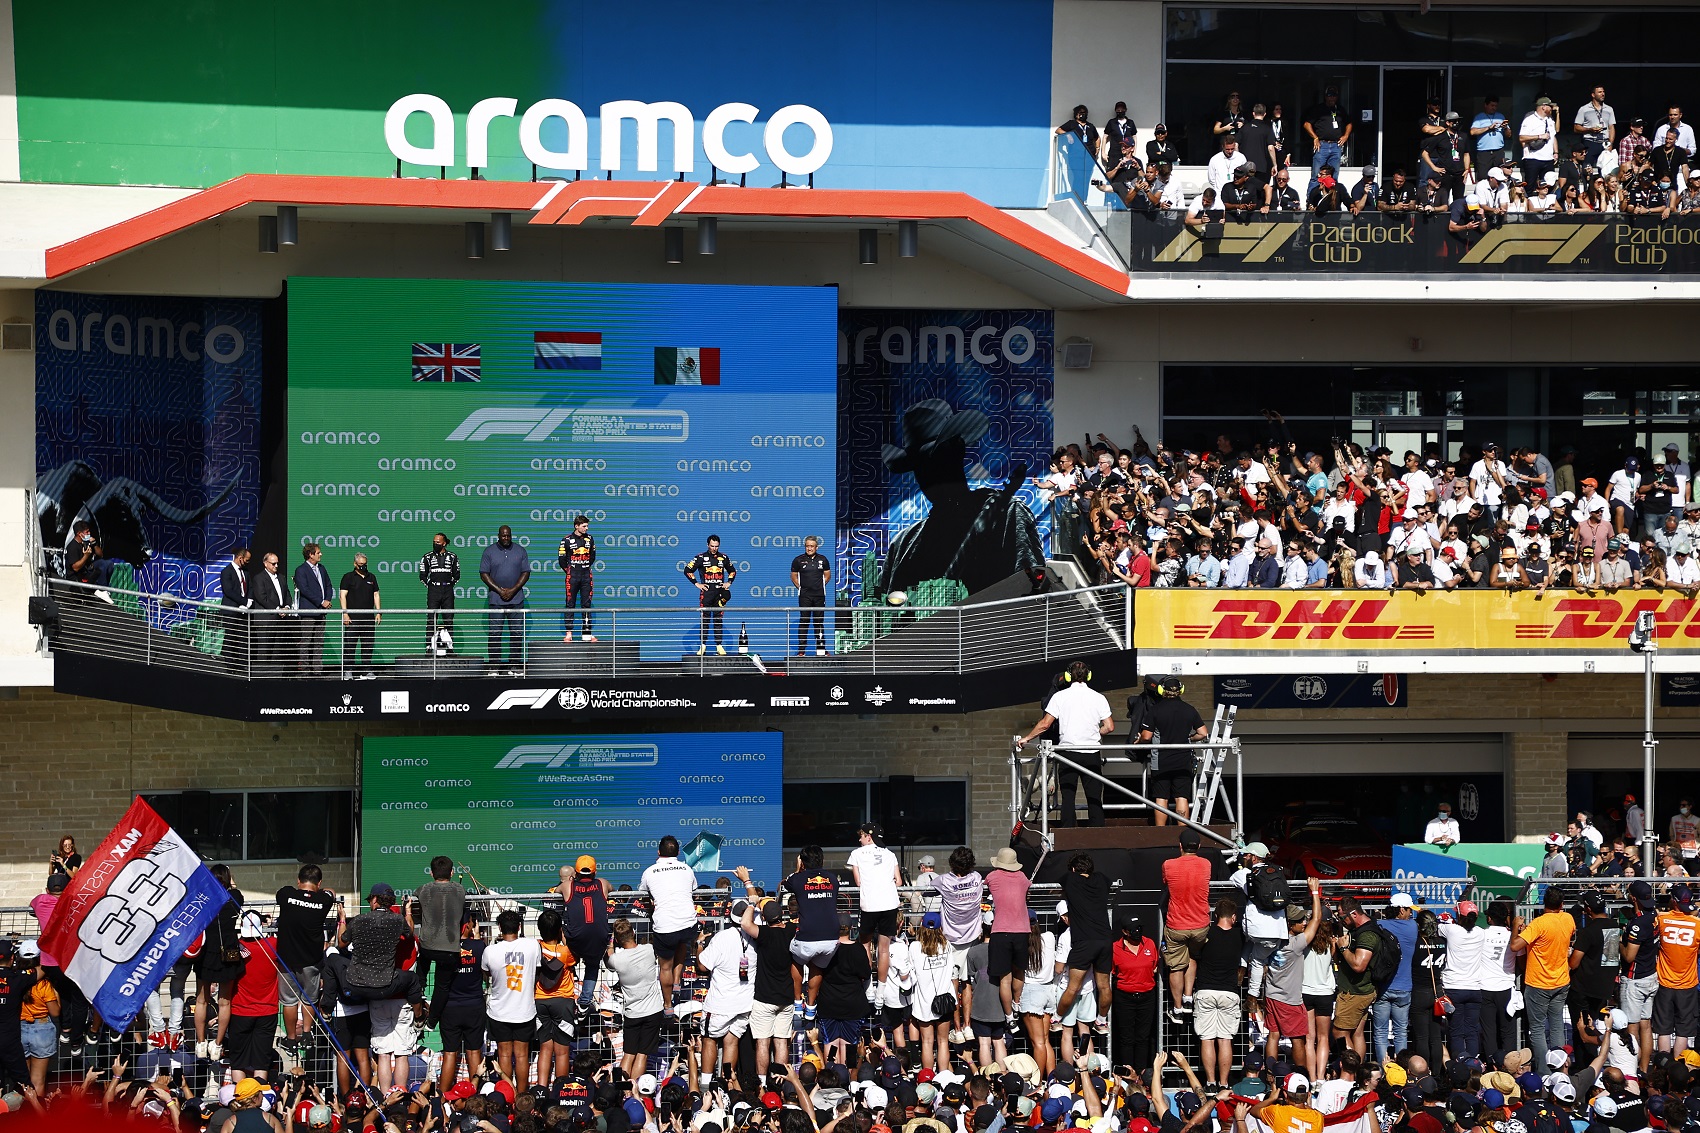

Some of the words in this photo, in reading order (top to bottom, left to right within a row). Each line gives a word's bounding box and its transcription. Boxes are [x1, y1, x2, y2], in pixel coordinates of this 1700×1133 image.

[384, 93, 834, 175] aramco
[1309, 222, 1414, 244] Paddock
[1309, 242, 1362, 263] Club
[1615, 245, 1667, 265] Club
[49, 309, 245, 364] aramco
[838, 325, 1035, 364] ramco
[35, 364, 160, 408] AUSTIN
[168, 373, 262, 414] 2021
[957, 378, 1054, 412] 2021
[35, 405, 160, 446] AUSTIN
[166, 413, 261, 451] 2021
[301, 431, 380, 445] aramco
[751, 435, 825, 448] aramco
[378, 458, 456, 471] aramco
[530, 458, 607, 471] aramco
[676, 459, 751, 472] aramco
[301, 483, 380, 497] aramco
[453, 484, 531, 497] aramco
[604, 484, 680, 497] aramco
[750, 485, 825, 498] aramco
[378, 509, 456, 522] aramco
[676, 510, 751, 523] aramco
[301, 535, 380, 548] aramco
[604, 535, 679, 548] aramco
[604, 585, 679, 598] aramco
[1207, 599, 1400, 639] DHL
[1549, 599, 1700, 639] DH
[559, 688, 588, 709] FIA
[591, 690, 607, 698] FIA
[609, 689, 650, 698] Formula
[591, 699, 621, 708] World
[622, 699, 690, 709] Championship
[714, 699, 754, 707] DHL
[770, 696, 810, 707] PIRELLI
[909, 698, 956, 706] #PurposeDriven
[329, 706, 364, 714] ROLEX
[425, 703, 470, 713] aramco
[381, 758, 429, 767] aramco
[721, 753, 766, 762] aramco
[424, 779, 472, 787] aramco
[538, 774, 615, 783] #WeRaceAsOne
[679, 775, 725, 783] aramco
[381, 801, 428, 810] aramco
[467, 799, 514, 808] aramco
[553, 798, 599, 807] aramco
[637, 796, 683, 806] aramco
[720, 795, 766, 804] aramco
[424, 822, 471, 831] aramco
[510, 820, 557, 829] aramco
[595, 818, 641, 827] aramco
[679, 817, 725, 826] aramco
[380, 845, 428, 854] aramco
[467, 843, 514, 851] aramco
[552, 841, 599, 850] aramco
[510, 863, 556, 873] aramco
[652, 866, 687, 874] PETRONAS
[820, 883, 833, 891] Bull
[1395, 868, 1463, 904] aramco
[287, 897, 323, 909] PETRONAS
[582, 896, 594, 923] 1
[1662, 926, 1696, 946] 33
[461, 957, 476, 965] Bull
[1420, 954, 1446, 968] 44
[1617, 1098, 1643, 1110] TRONAS
